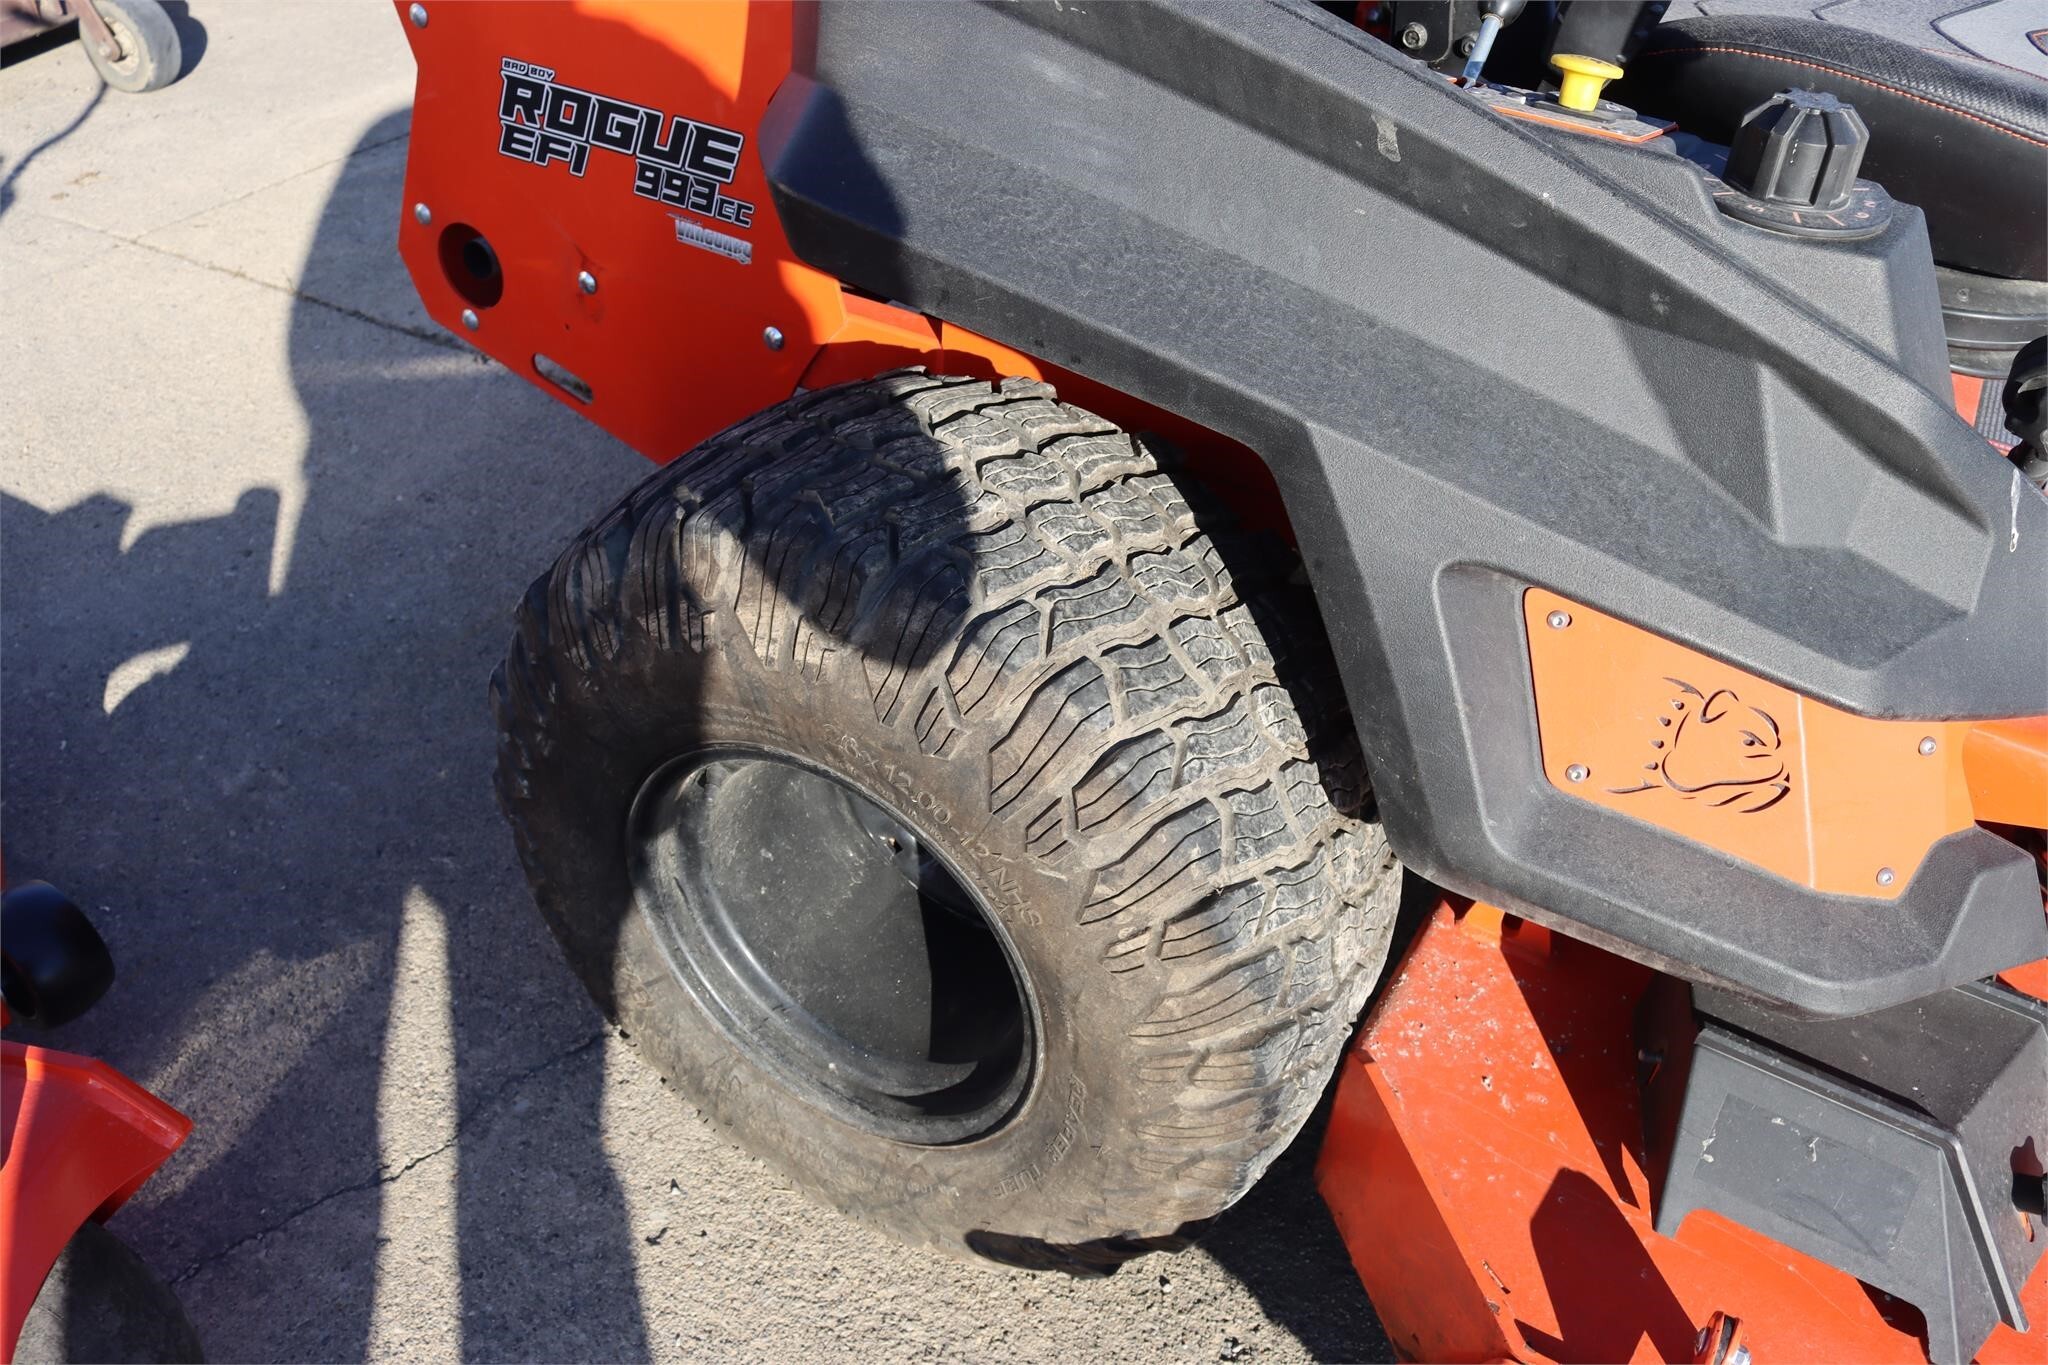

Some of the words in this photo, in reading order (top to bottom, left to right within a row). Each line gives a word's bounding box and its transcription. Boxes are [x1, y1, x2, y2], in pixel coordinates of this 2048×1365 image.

[502, 57, 528, 76] BAD
[529, 64, 555, 83] BOY
[499, 71, 745, 183] ROGUE
[499, 121, 590, 178] EFI
